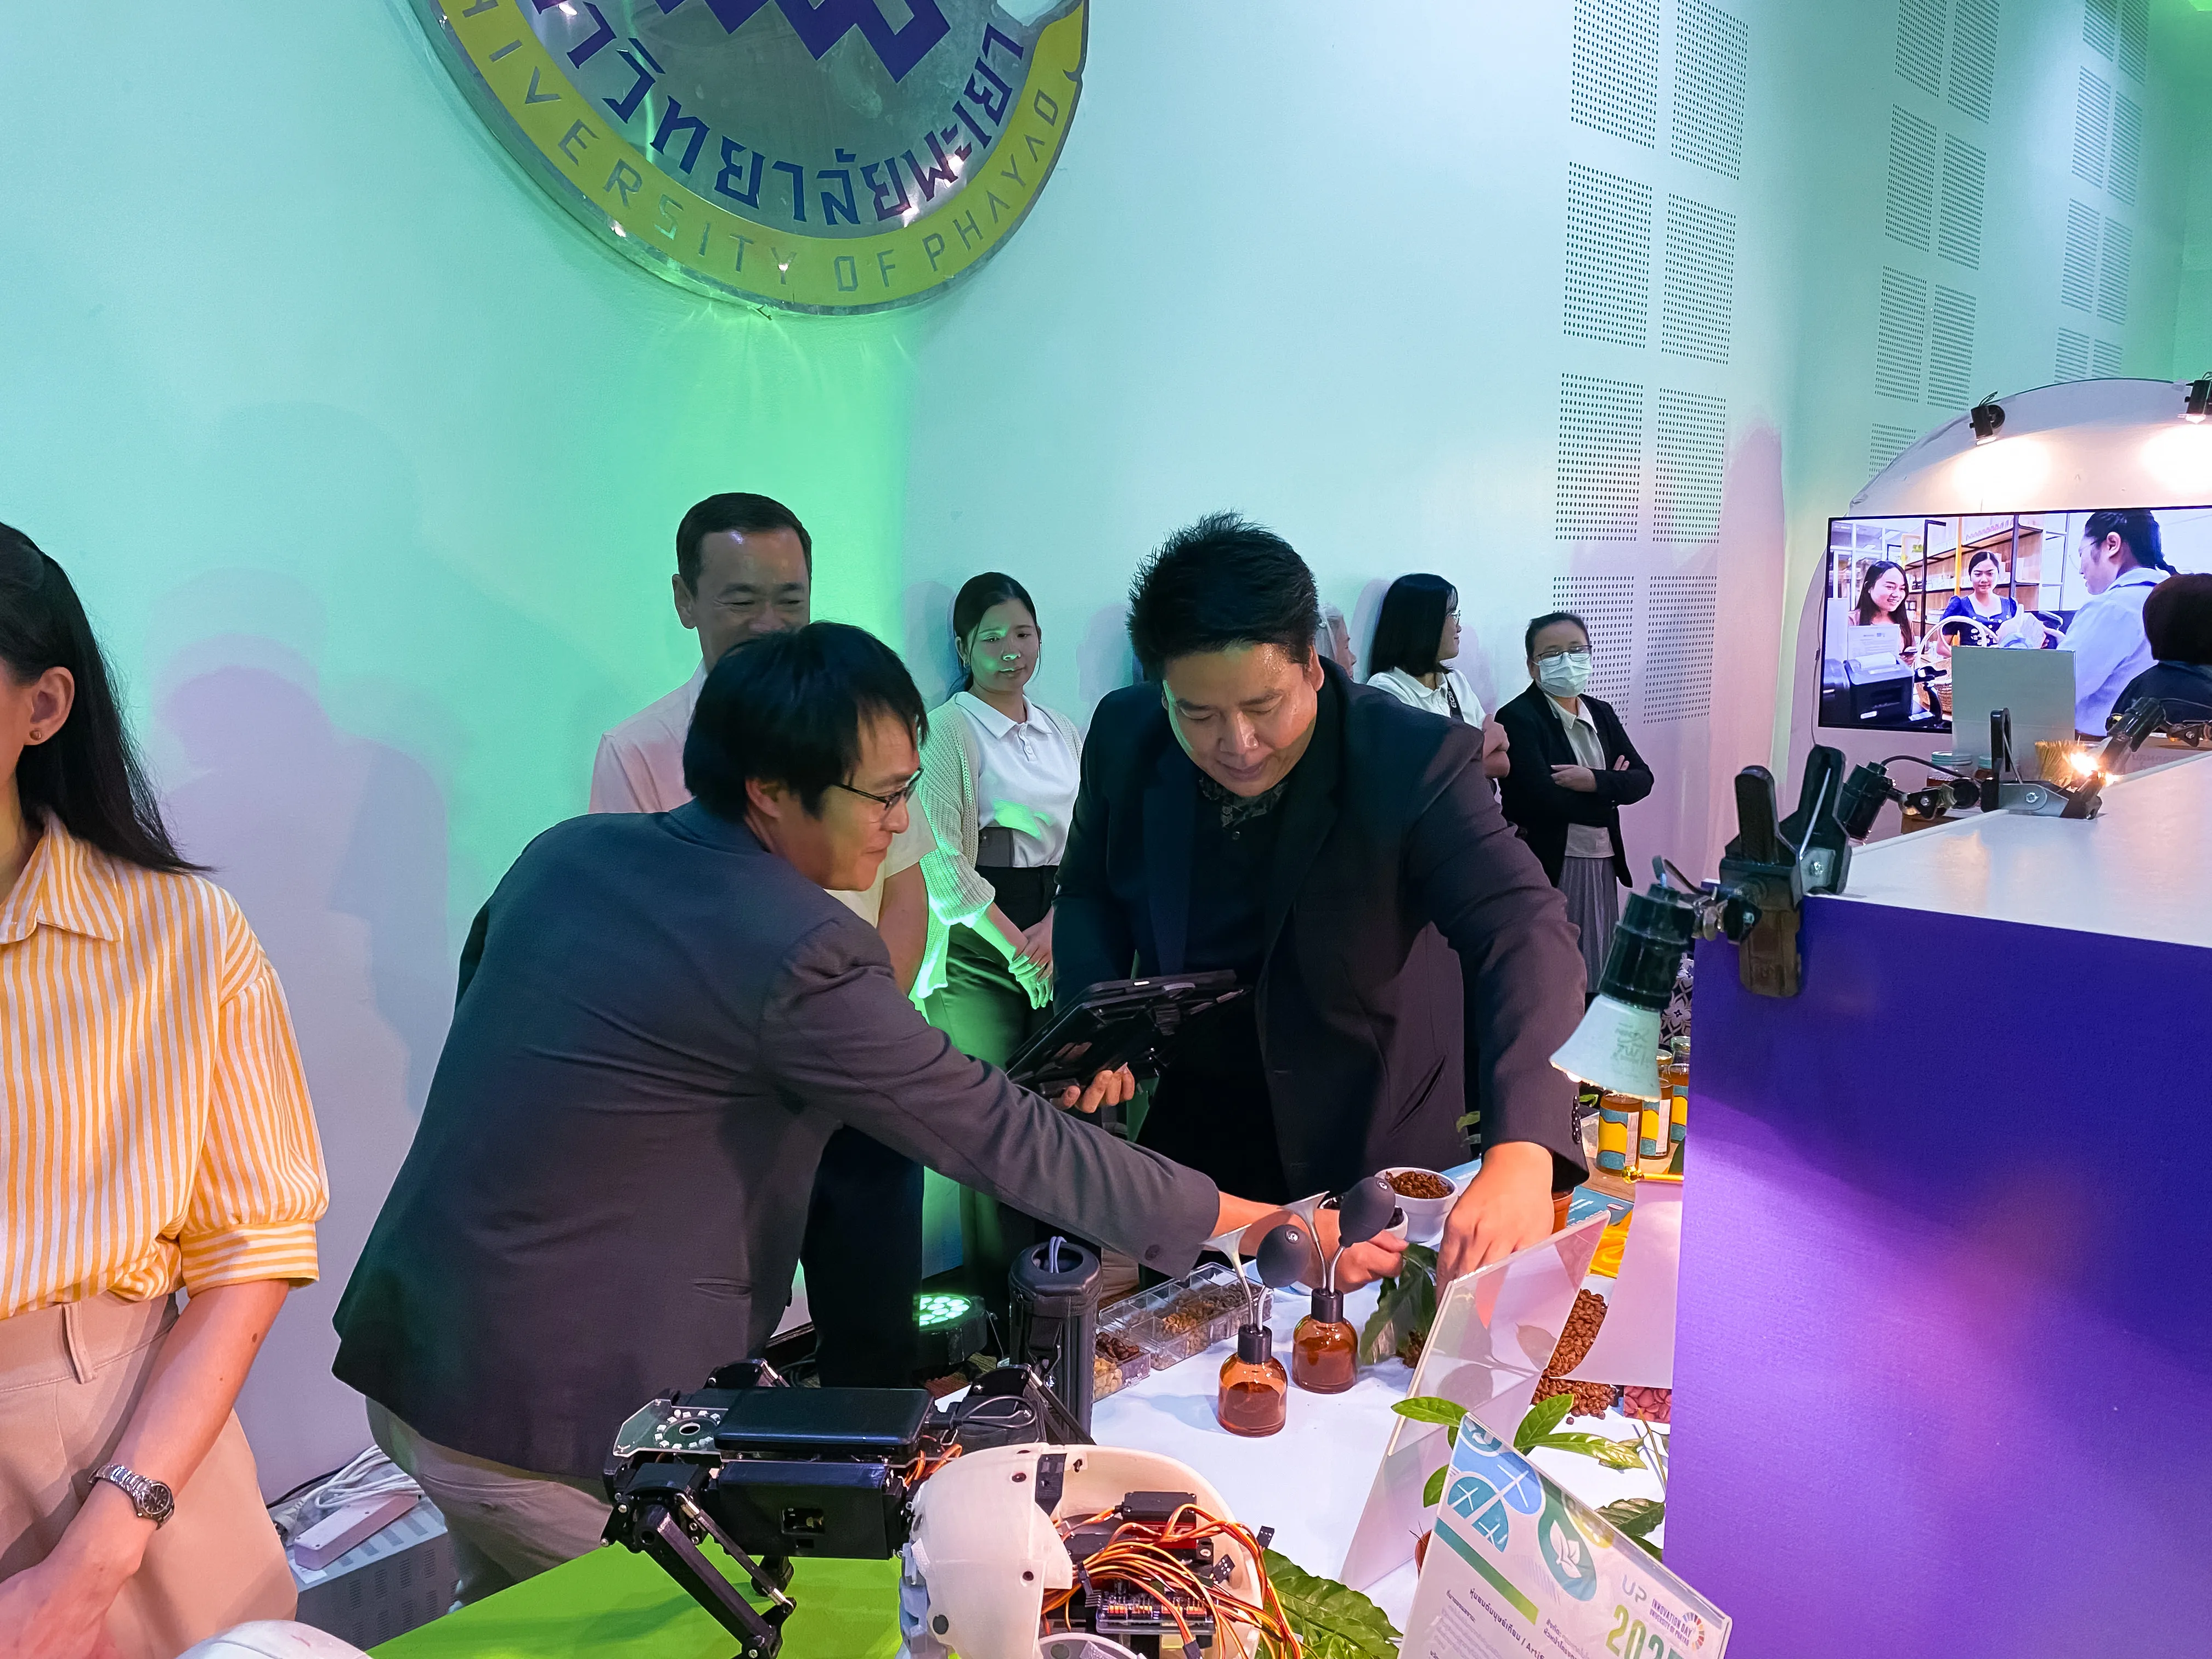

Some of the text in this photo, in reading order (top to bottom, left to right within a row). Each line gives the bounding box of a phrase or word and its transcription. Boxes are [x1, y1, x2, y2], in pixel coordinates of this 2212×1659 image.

[532, 0, 1024, 225] าวิทยาลัยพะเยา
[833, 249, 896, 292] OF
[922, 89, 1059, 272] PHAYAO
[1606, 1604, 1684, 1659] 202
[1651, 1599, 1692, 1638] INNOVATION DAY
